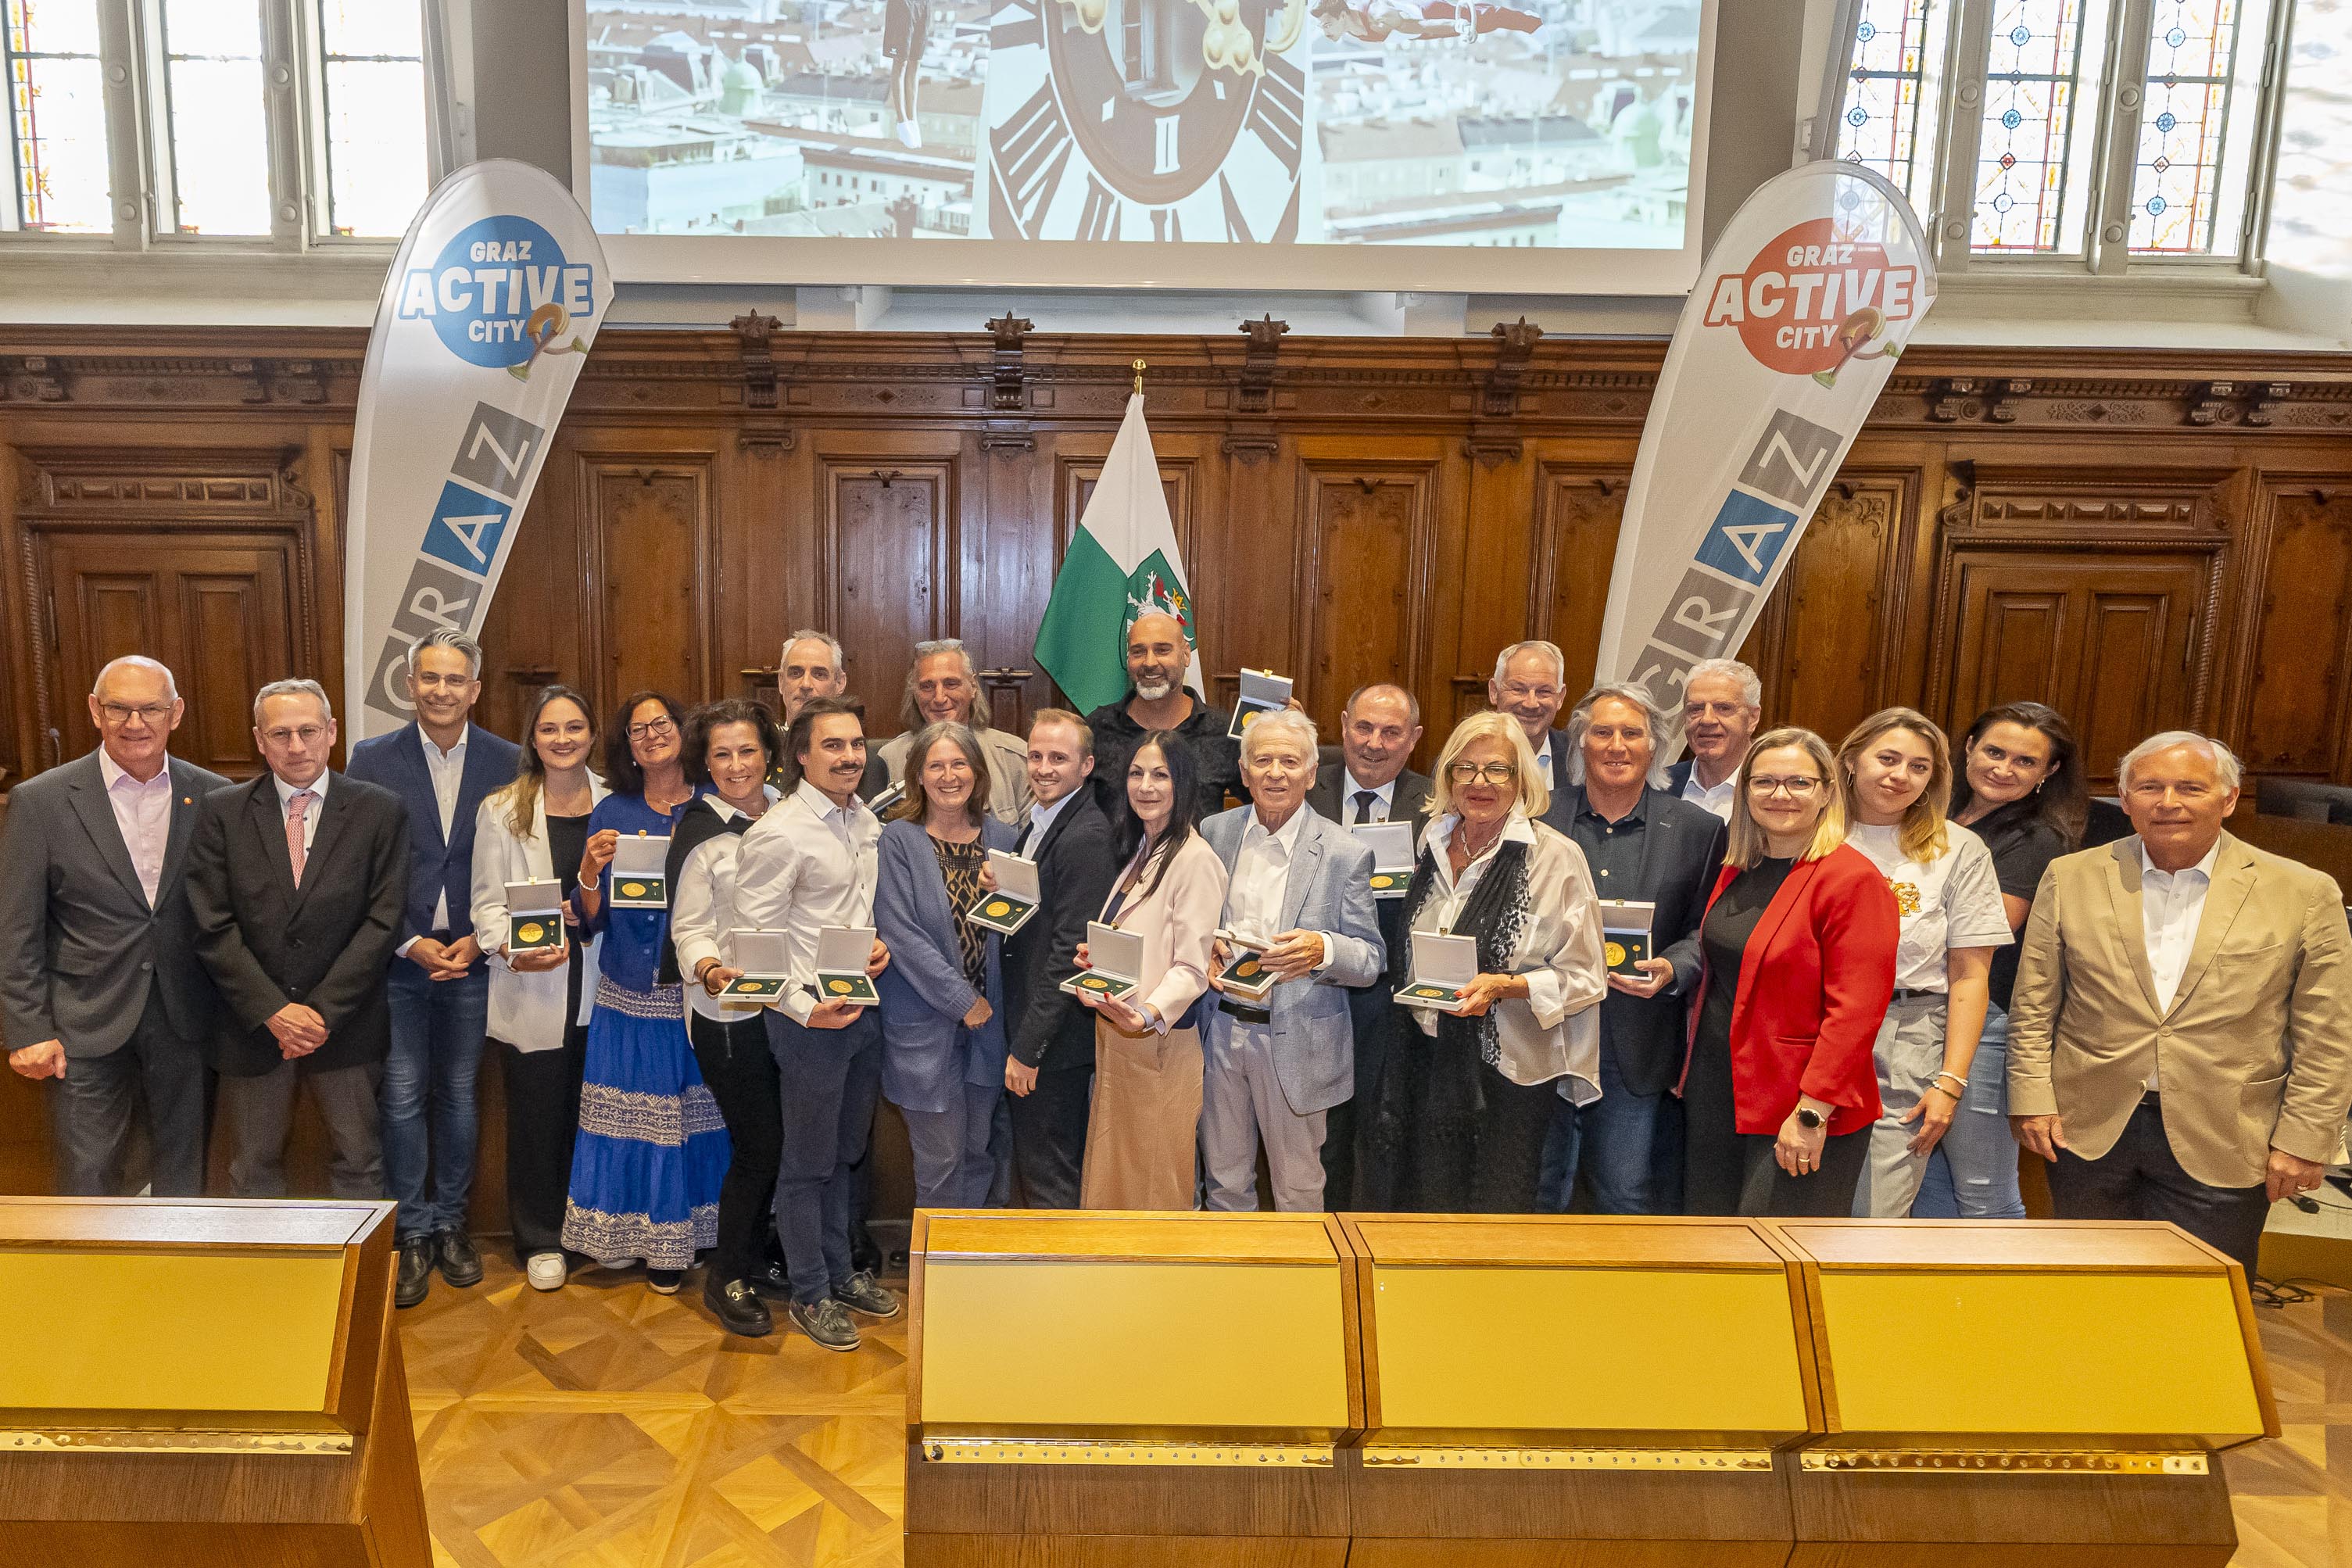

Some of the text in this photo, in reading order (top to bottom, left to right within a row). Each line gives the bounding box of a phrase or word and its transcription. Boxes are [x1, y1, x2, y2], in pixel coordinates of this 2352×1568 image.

[470, 241, 532, 263] GRAZ
[1786, 243, 1855, 267] GRAZ
[402, 265, 590, 317] ACTIVE
[1707, 268, 1913, 323] ACTIVE
[468, 319, 526, 342] CITY
[1775, 324, 1838, 349] CITY
[1638, 429, 1828, 718] GRAZ
